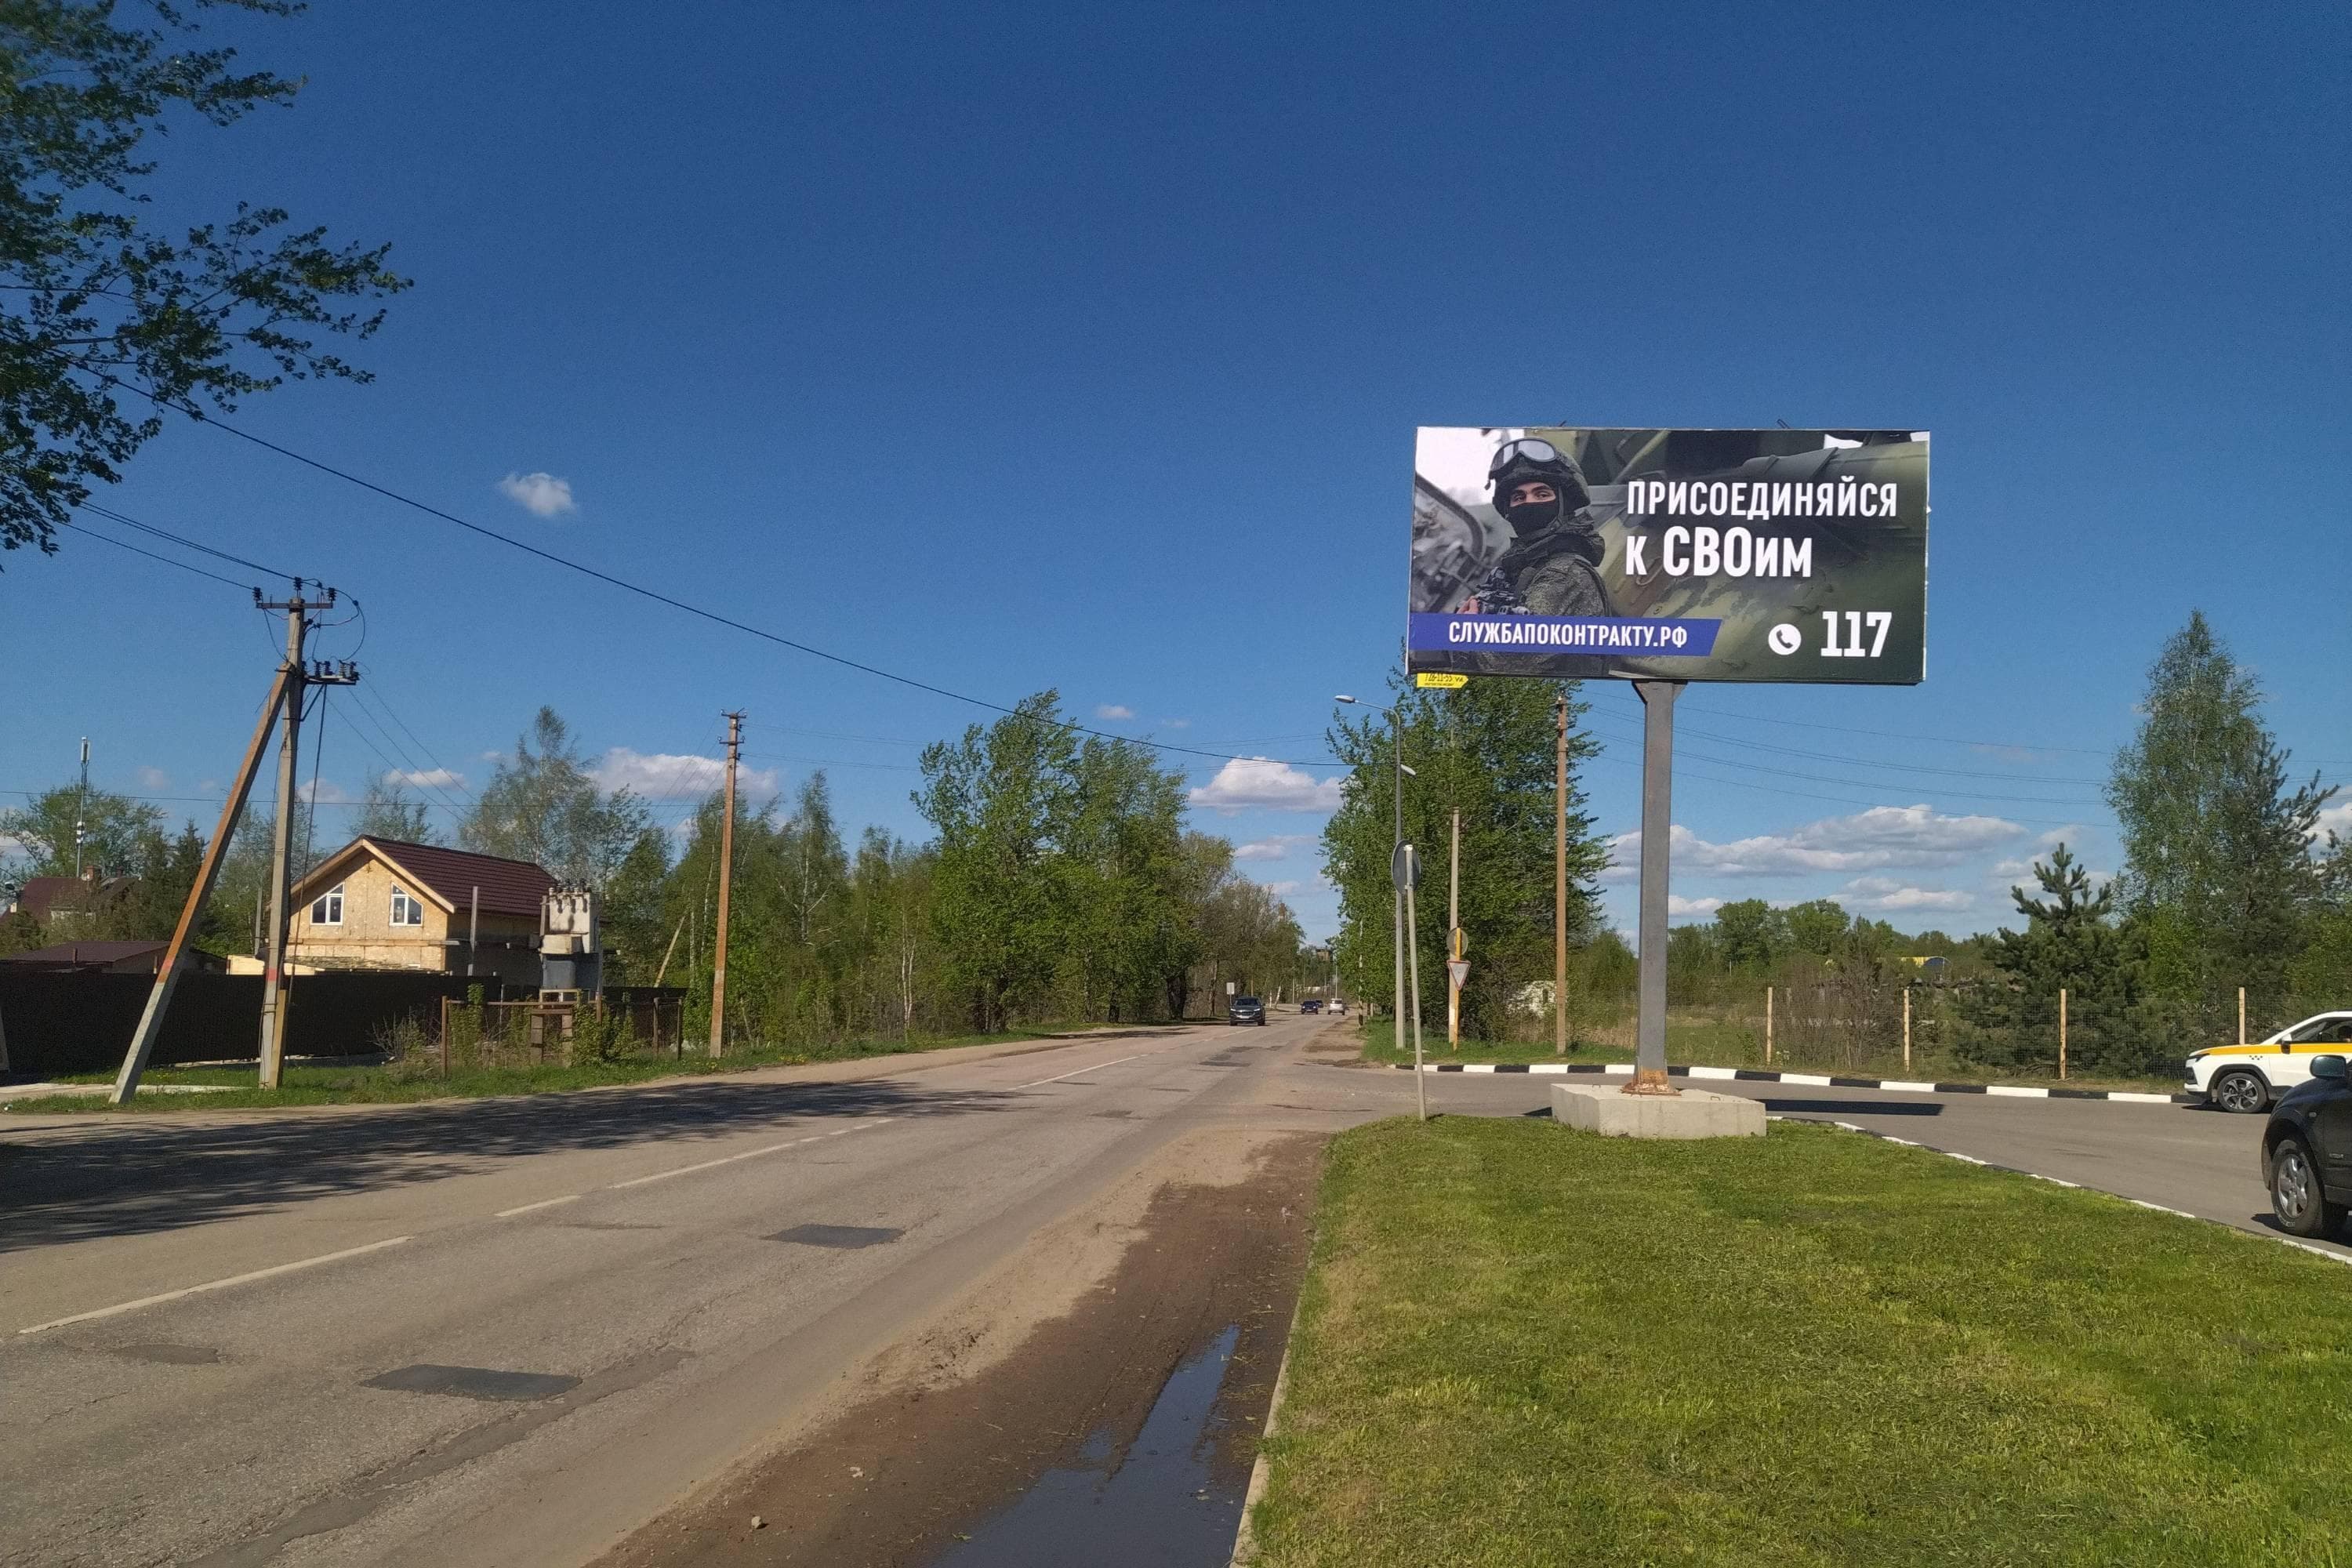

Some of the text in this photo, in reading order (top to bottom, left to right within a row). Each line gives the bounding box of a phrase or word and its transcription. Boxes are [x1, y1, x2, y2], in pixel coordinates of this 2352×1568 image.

[1627, 475, 1898, 521] ПРИСОЕДИНЯЙСЯ
[1662, 525, 1813, 578] СВОим
[1448, 621, 1688, 648] СЛУЖБАПОКОНТРАКТУ.РФ
[1820, 611, 1893, 657] 117
